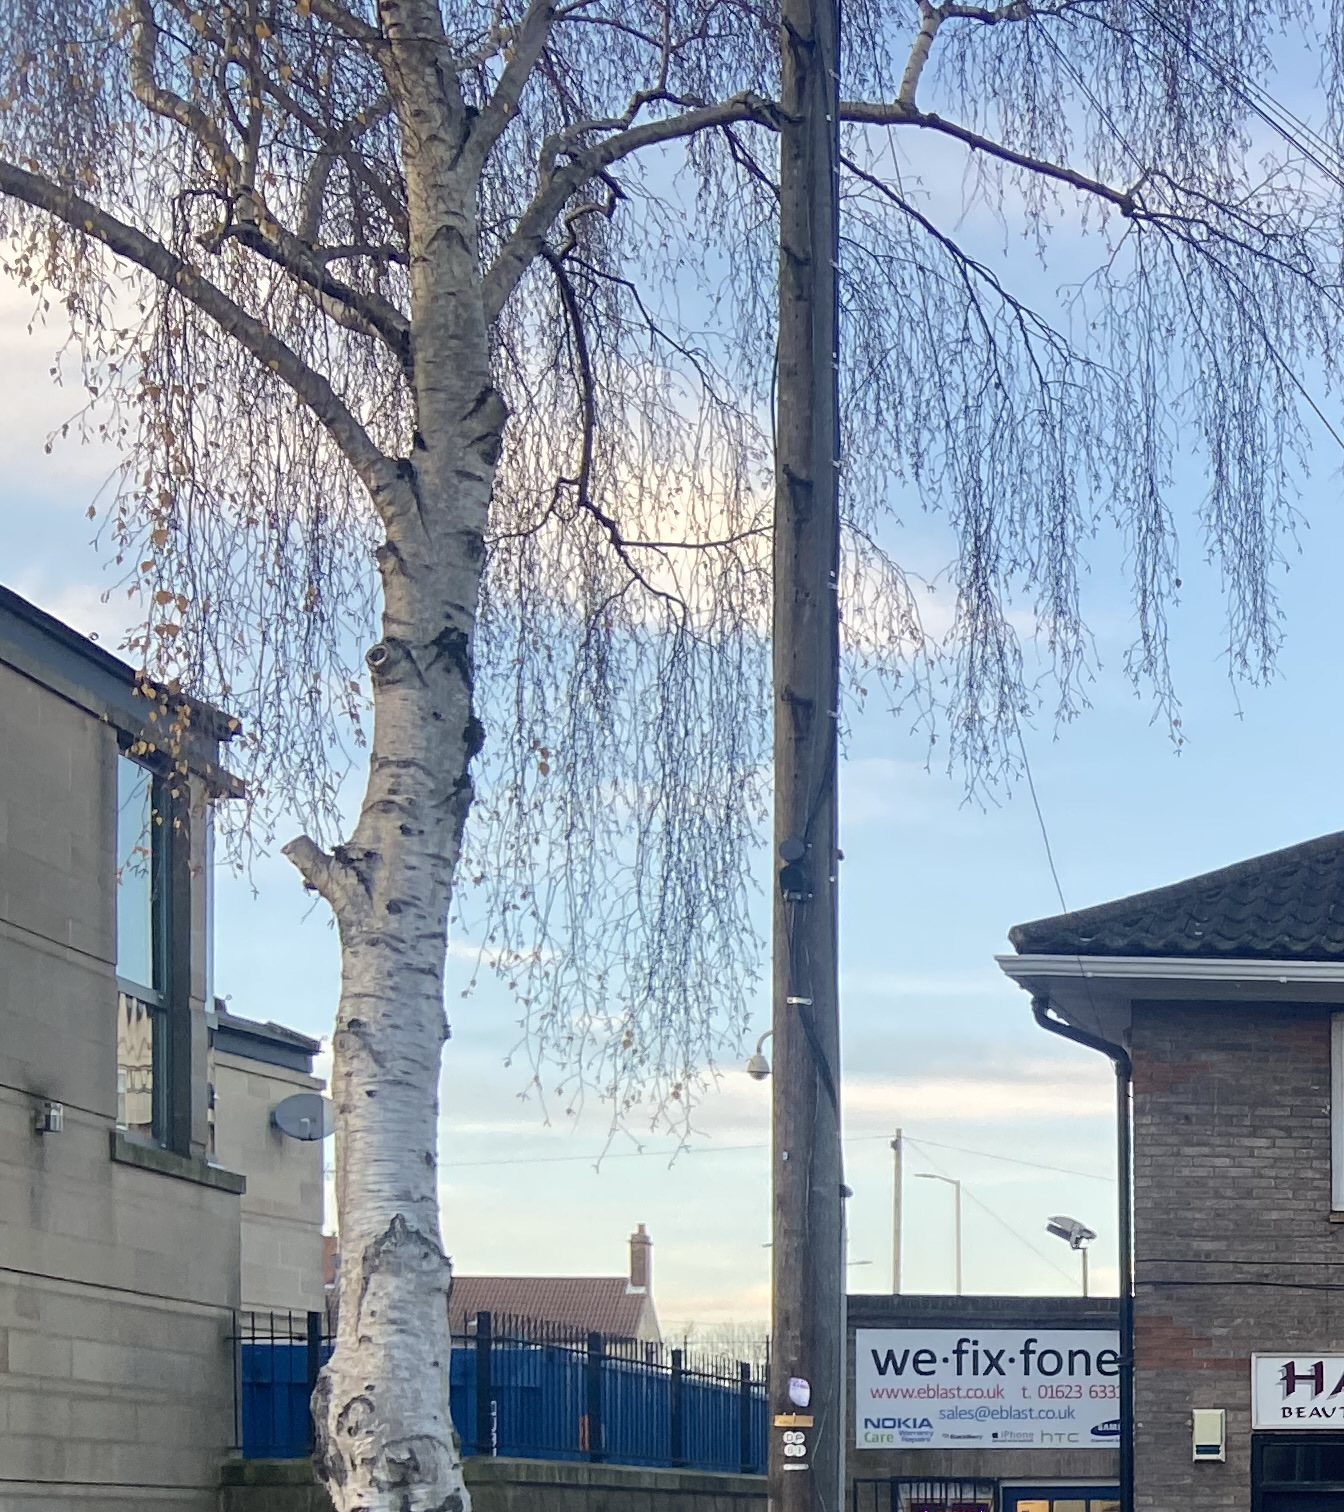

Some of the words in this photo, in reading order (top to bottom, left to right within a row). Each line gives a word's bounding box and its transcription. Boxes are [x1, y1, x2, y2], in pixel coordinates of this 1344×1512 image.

[870, 1384, 1005, 1400] www.eblast.co.uk
[1037, 1384, 1083, 1400] 01623
[939, 1405, 1076, 1422] sales@eblast.co.uk
[864, 1417, 934, 1429] NOKIA
[864, 1431, 894, 1443] Care
[1000, 1430, 1034, 1439] iPhone
